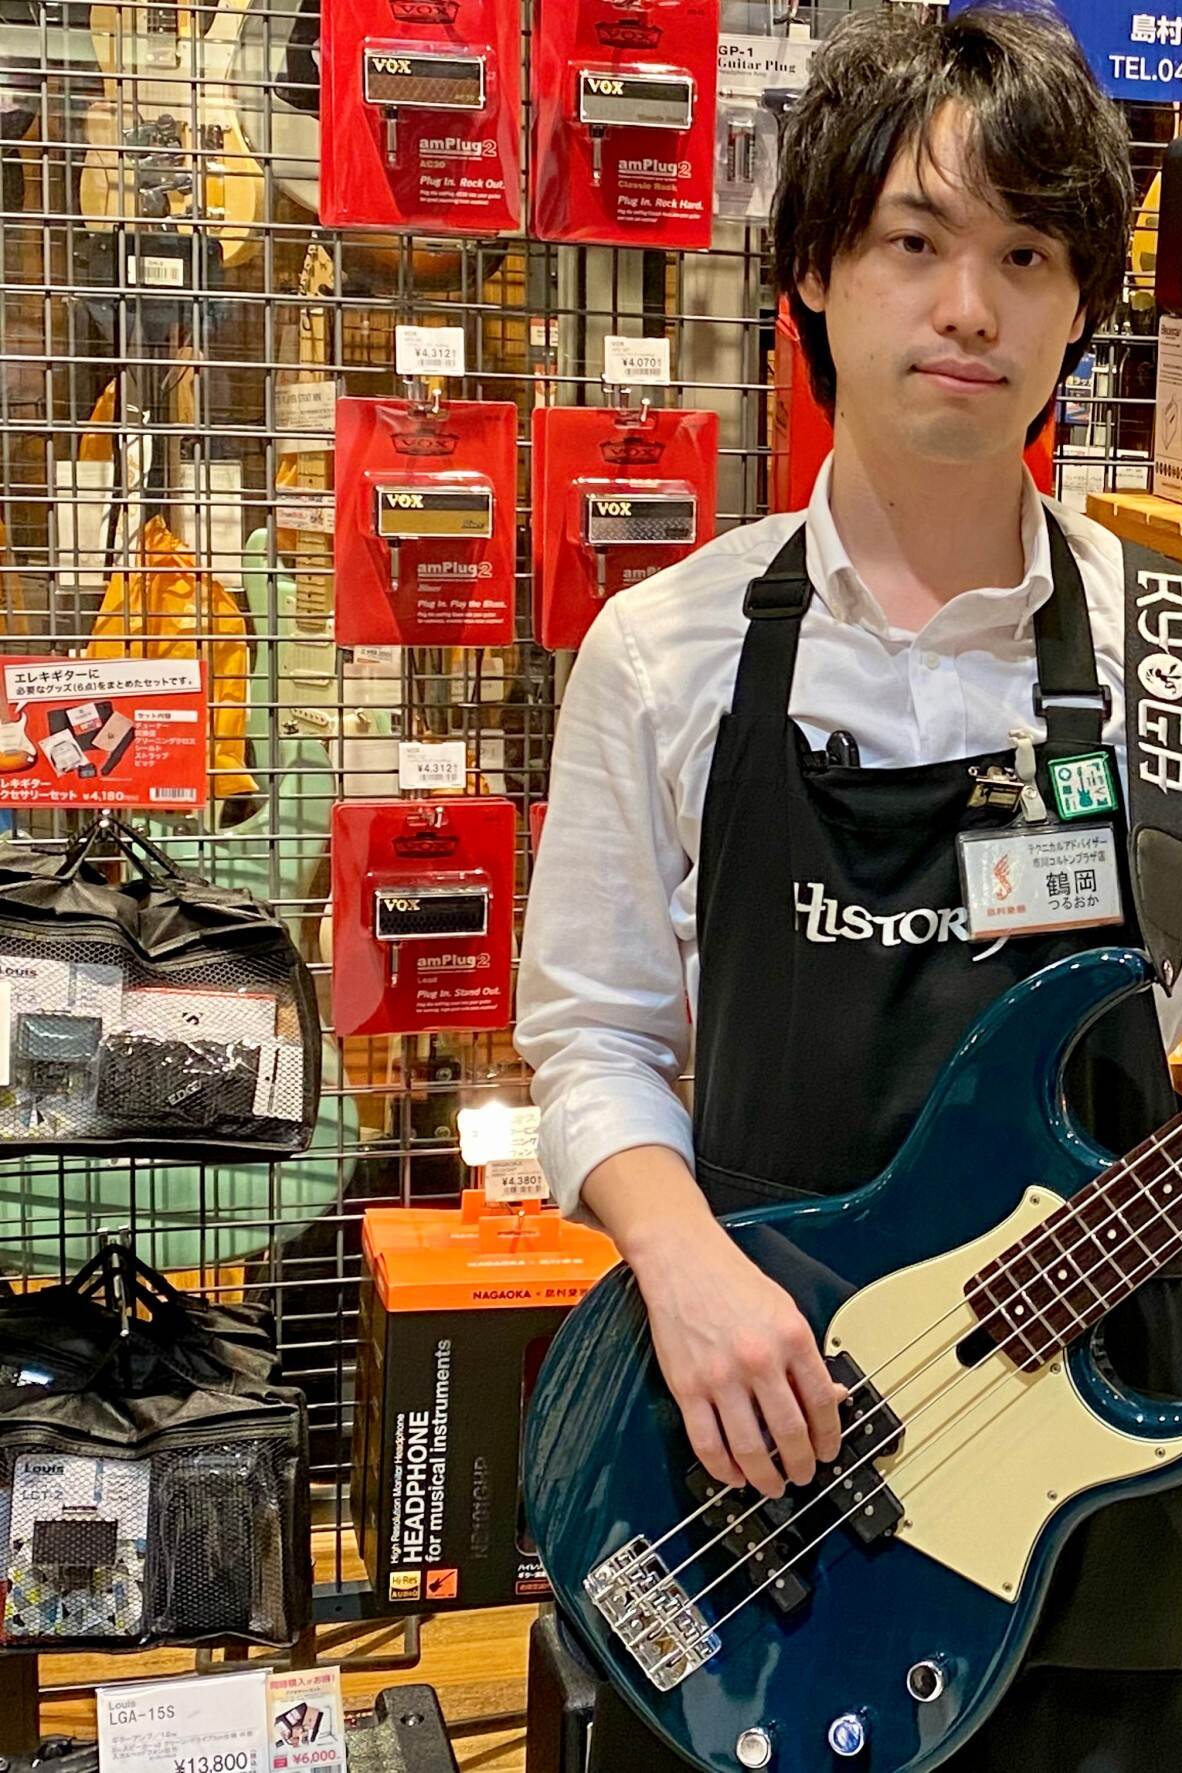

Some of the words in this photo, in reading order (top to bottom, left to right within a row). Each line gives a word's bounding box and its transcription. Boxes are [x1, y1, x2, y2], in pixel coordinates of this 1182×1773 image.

[718, 46, 753, 57] GP-1
[372, 58, 411, 74] VOX
[718, 56, 761, 71] Guitar
[765, 61, 796, 73] Plug
[587, 79, 624, 95] VOX
[420, 138, 497, 157] amPlug2
[420, 160, 446, 169] AC30
[618, 159, 692, 179] amPlug2
[420, 176, 441, 187] Plug
[444, 178, 456, 187] In.
[460, 177, 483, 188] Rock
[485, 179, 506, 189] Out.
[618, 196, 638, 207] Plug
[655, 198, 677, 208] Rock
[679, 200, 704, 210] Hard.
[387, 494, 423, 509] VOX
[597, 503, 632, 516] VOX
[418, 562, 493, 578] amPlug2
[15, 668, 100, 684] エレキギターに
[1046, 869, 1097, 897] 鶴岡
[384, 900, 421, 912] VOX
[1048, 895, 1099, 910] つるおか
[417, 953, 490, 970] amPlug2
[417, 989, 436, 1000] Plug
[455, 988, 480, 998] Stand
[482, 987, 501, 996] Out.
[167, 1079, 203, 1105] EDGE
[472, 1289, 531, 1301] NAGAOKA
[430, 1339, 451, 1453] instruments
[24, 1463, 65, 1475] Louis
[390, 1542, 399, 1565] High
[395, 1413, 406, 1464] Headphone
[403, 1411, 430, 1563] HEADPHONE
[428, 1457, 446, 1537] musical
[425, 1542, 441, 1563] for
[392, 1575, 418, 1586] Hi-Res
[391, 1590, 418, 1598] AUDIO
[109, 1701, 136, 1711] Louis
[109, 1705, 175, 1726] LGA-15S
[174, 1752, 248, 1773] ¥13,800
[293, 1749, 336, 1764] ¥6,000
